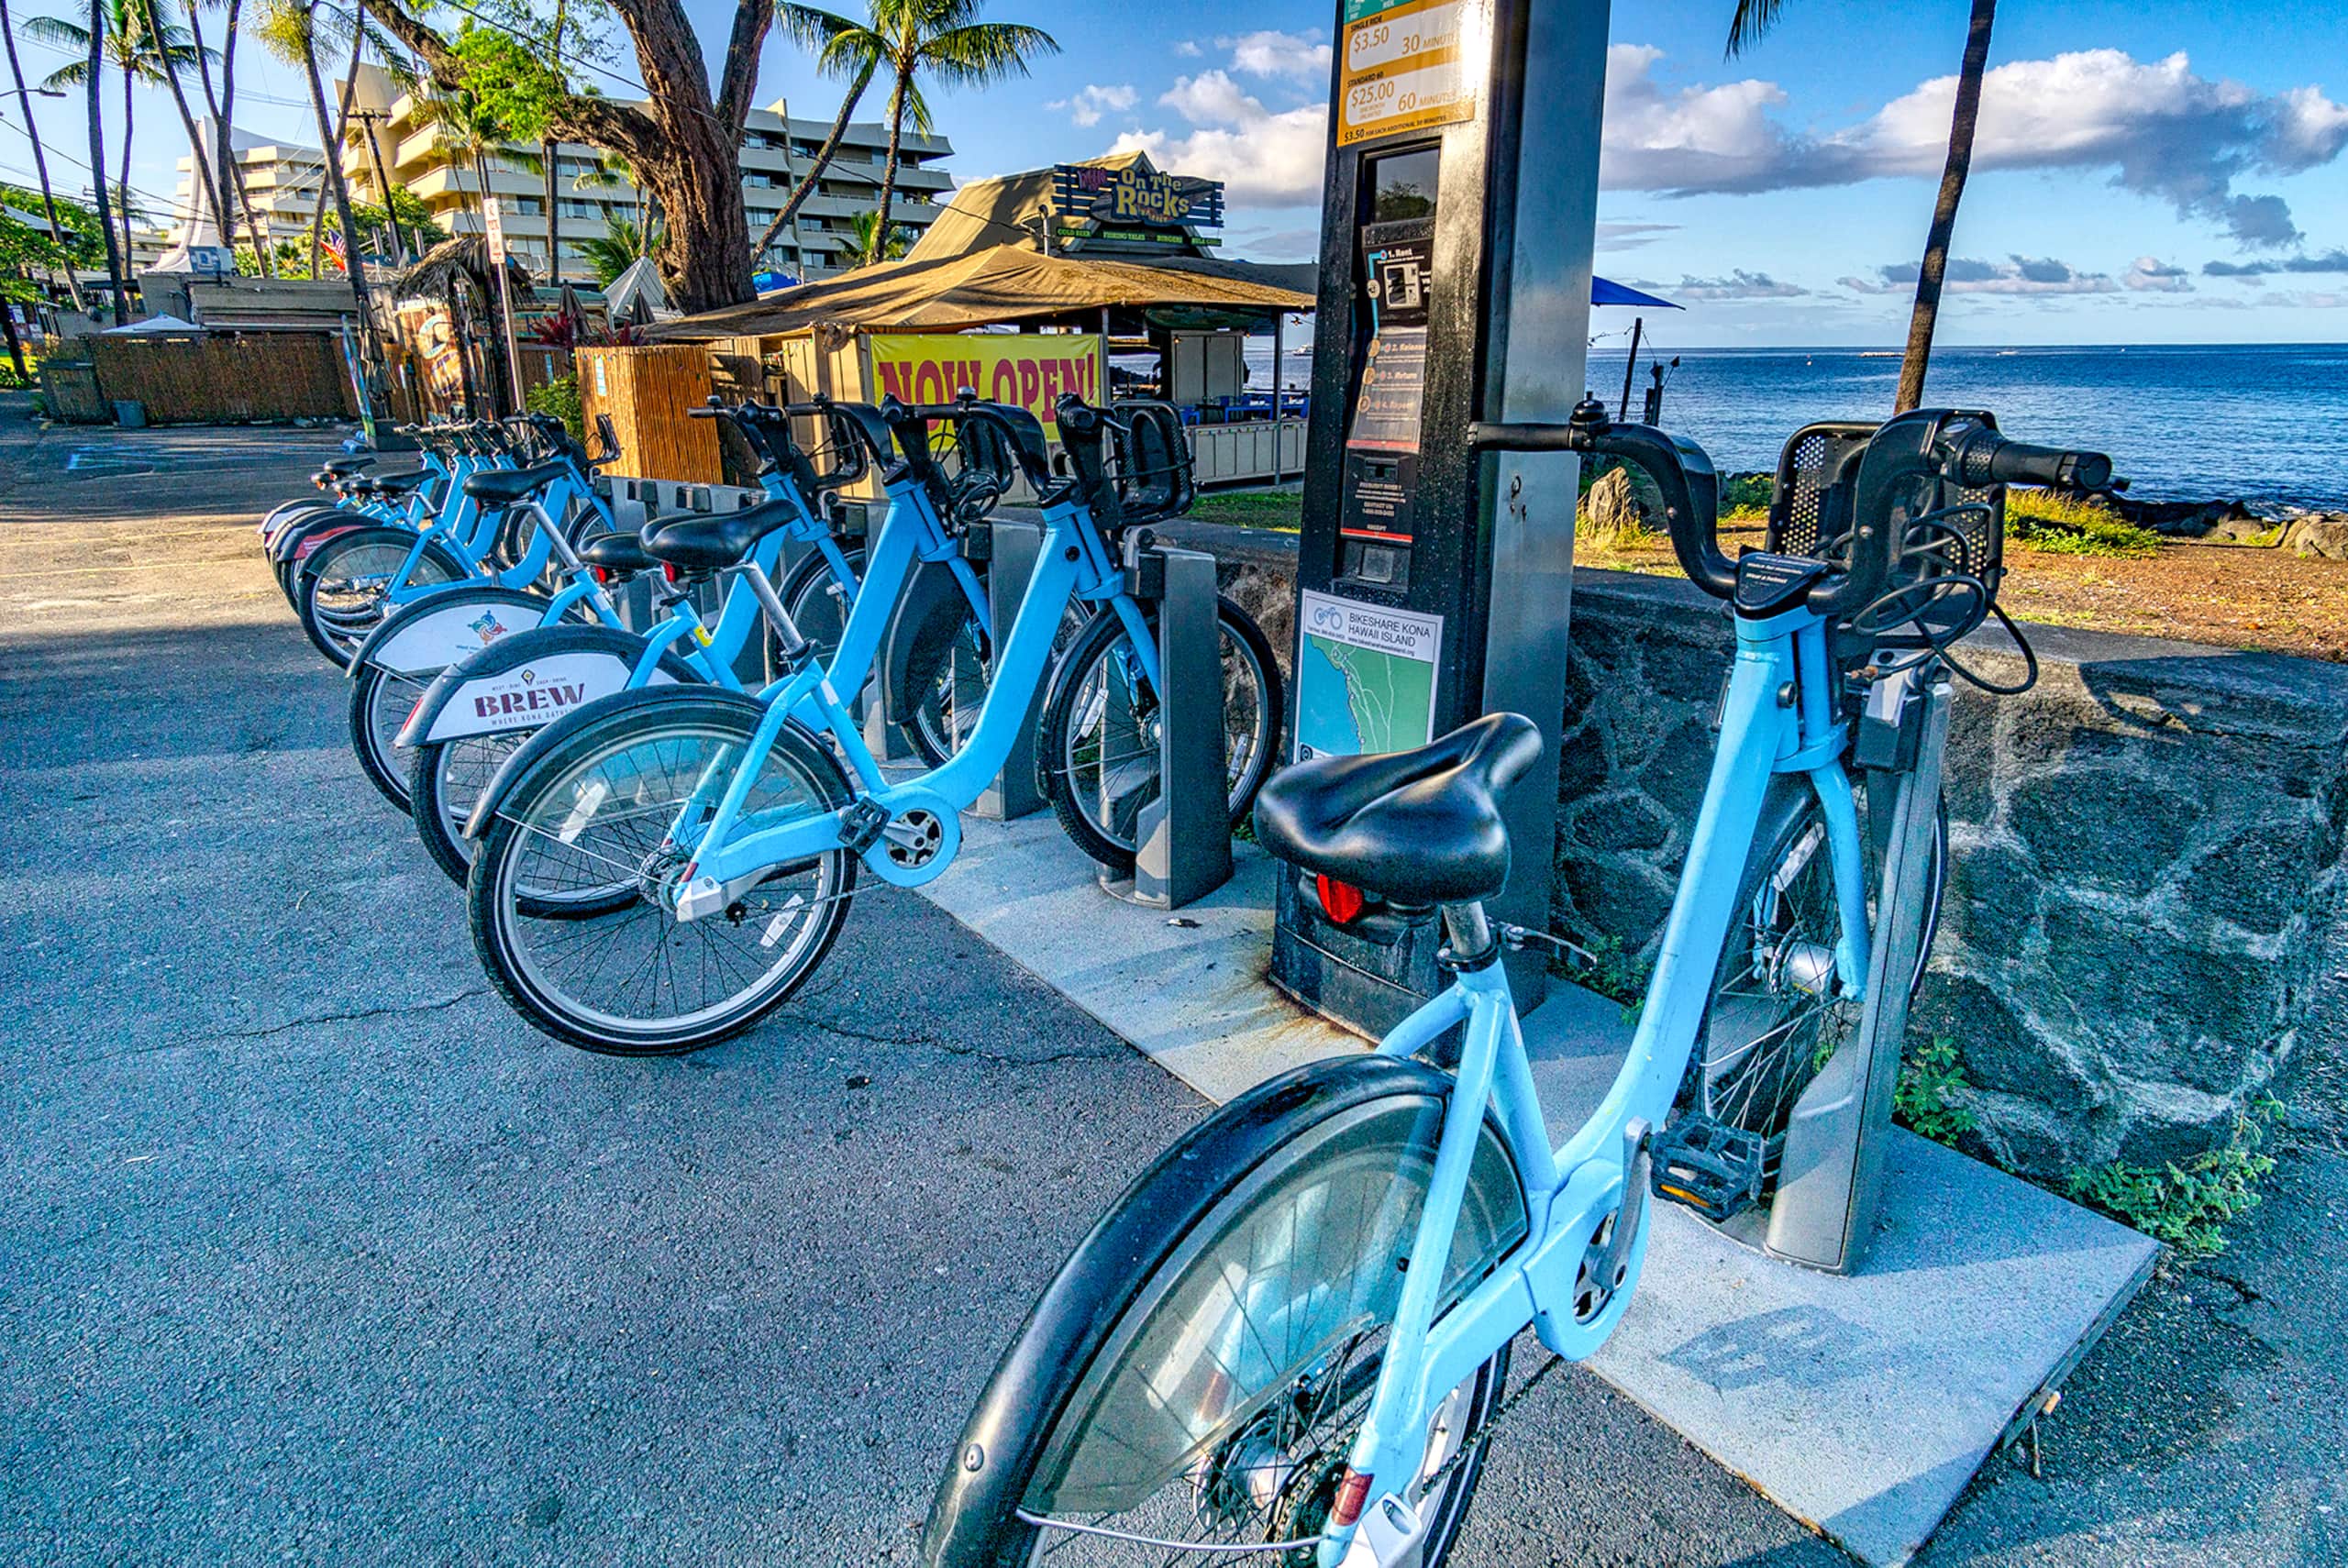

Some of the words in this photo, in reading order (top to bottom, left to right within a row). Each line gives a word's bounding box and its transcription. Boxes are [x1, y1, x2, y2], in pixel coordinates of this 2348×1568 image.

[1350, 19, 1368, 32] SINGLE
[1369, 15, 1382, 25] RIDE
[1354, 26, 1390, 53] $3.50
[1401, 34, 1421, 55] 30
[1423, 30, 1458, 49] MINUTE
[1347, 73, 1375, 88] STANDARD
[1352, 81, 1394, 108] $25.00
[1398, 92, 1417, 112] 60
[1344, 128, 1365, 143] $3.50
[1423, 116, 1446, 125] MINUTES
[1121, 169, 1146, 190] On
[1149, 171, 1182, 192] The
[1115, 184, 1190, 217] Rocks
[1395, 248, 1412, 258] Rent
[878, 360, 981, 430] NOW
[992, 352, 1094, 423] OPEN!
[1348, 624, 1379, 639] HAWAII
[1381, 631, 1416, 647] ISLAND
[1349, 613, 1400, 632] BIKESHARE
[1401, 624, 1431, 638] KONA
[474, 682, 585, 718] BREW
[492, 717, 517, 726] WHERE
[521, 712, 542, 722] KONA
